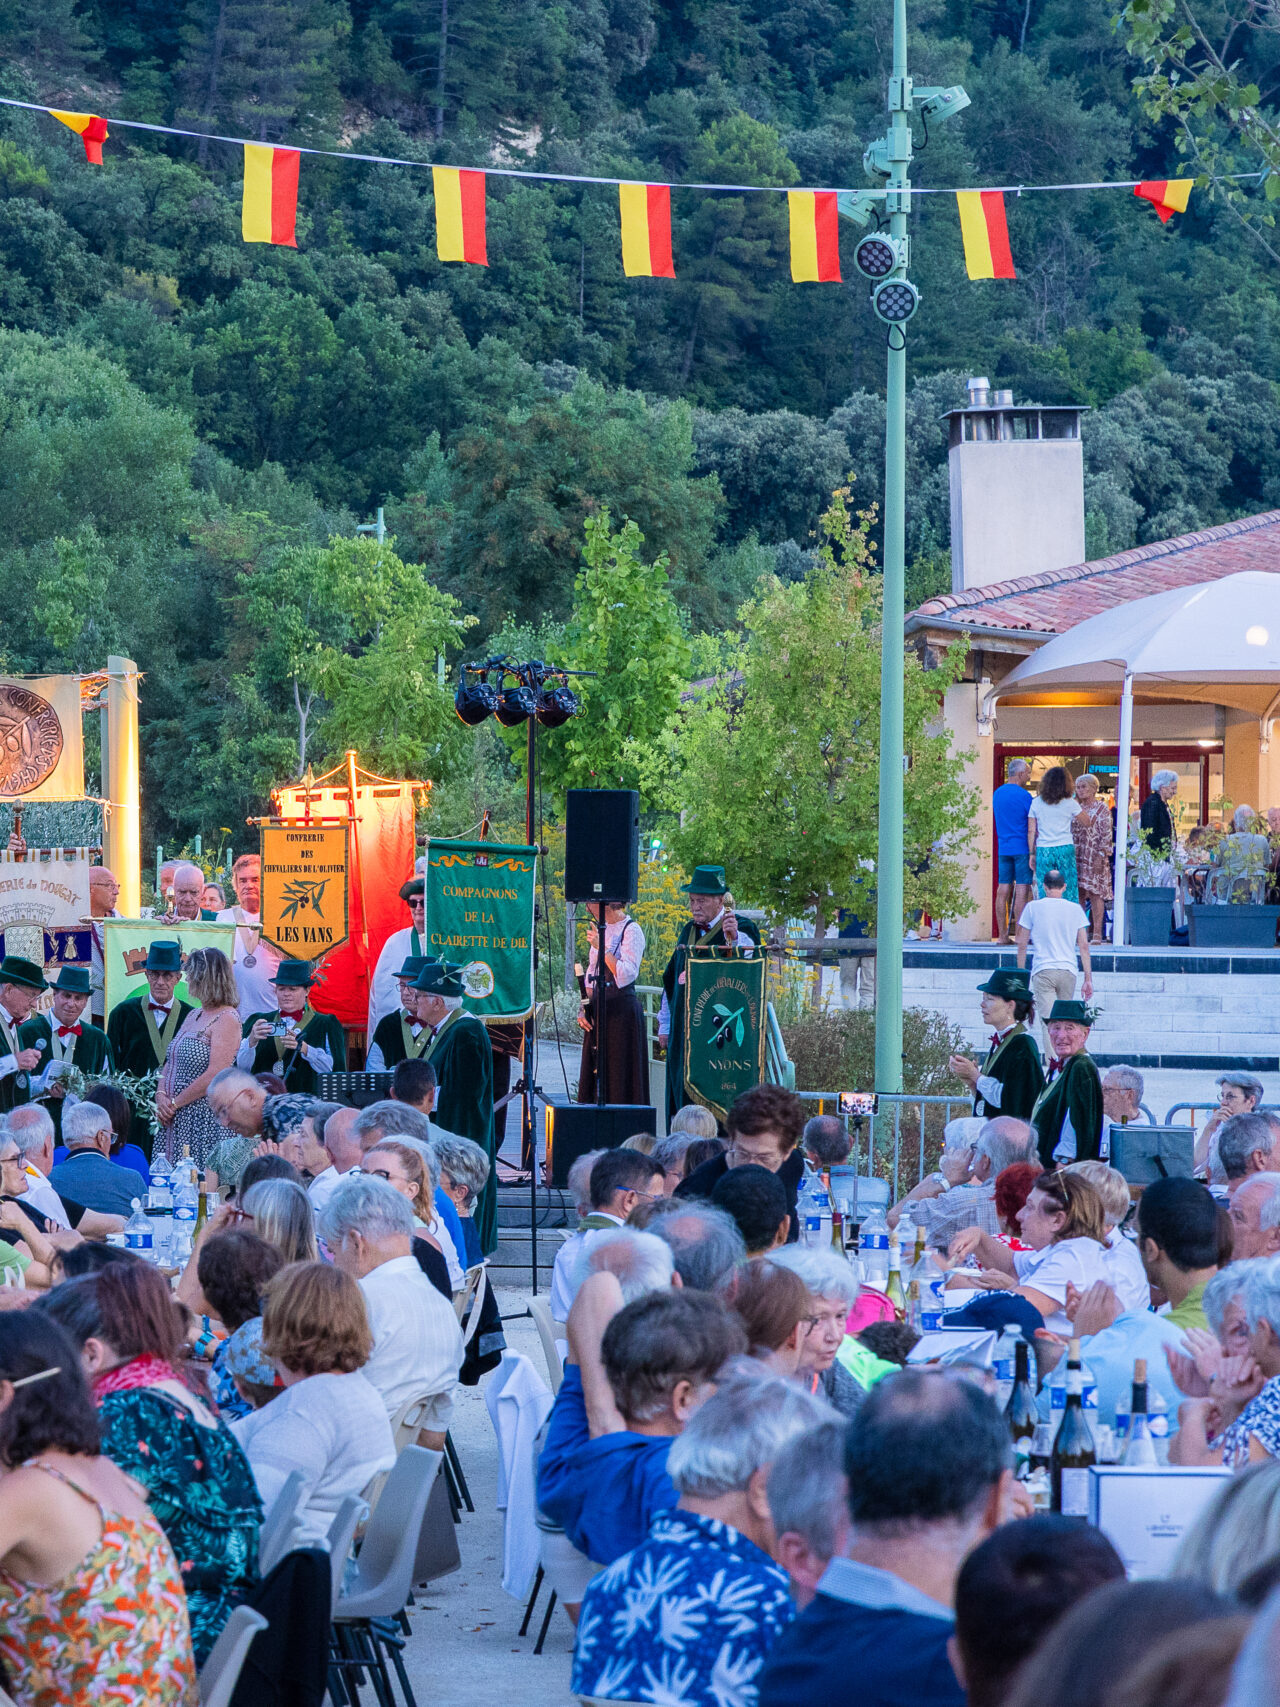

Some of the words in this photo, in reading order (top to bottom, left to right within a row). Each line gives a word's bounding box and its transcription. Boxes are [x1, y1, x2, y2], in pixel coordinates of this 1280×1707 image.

[7, 689, 59, 746] CONFRERIE
[35, 747, 56, 770] DES
[286, 833, 325, 842] CONFRERIE
[301, 850, 313, 859] DES
[264, 864, 303, 873] CHEVALIERS
[303, 864, 312, 873] DE
[442, 885, 518, 900] COMPAGNONS
[464, 911, 478, 922] DE
[481, 912, 495, 924] LA
[276, 926, 299, 943] LES
[303, 926, 333, 943] VANS
[430, 933, 489, 948] CLAIRETTE
[493, 937, 507, 949] DE
[510, 937, 528, 949] DIE
[709, 1059, 752, 1071] NYONS
